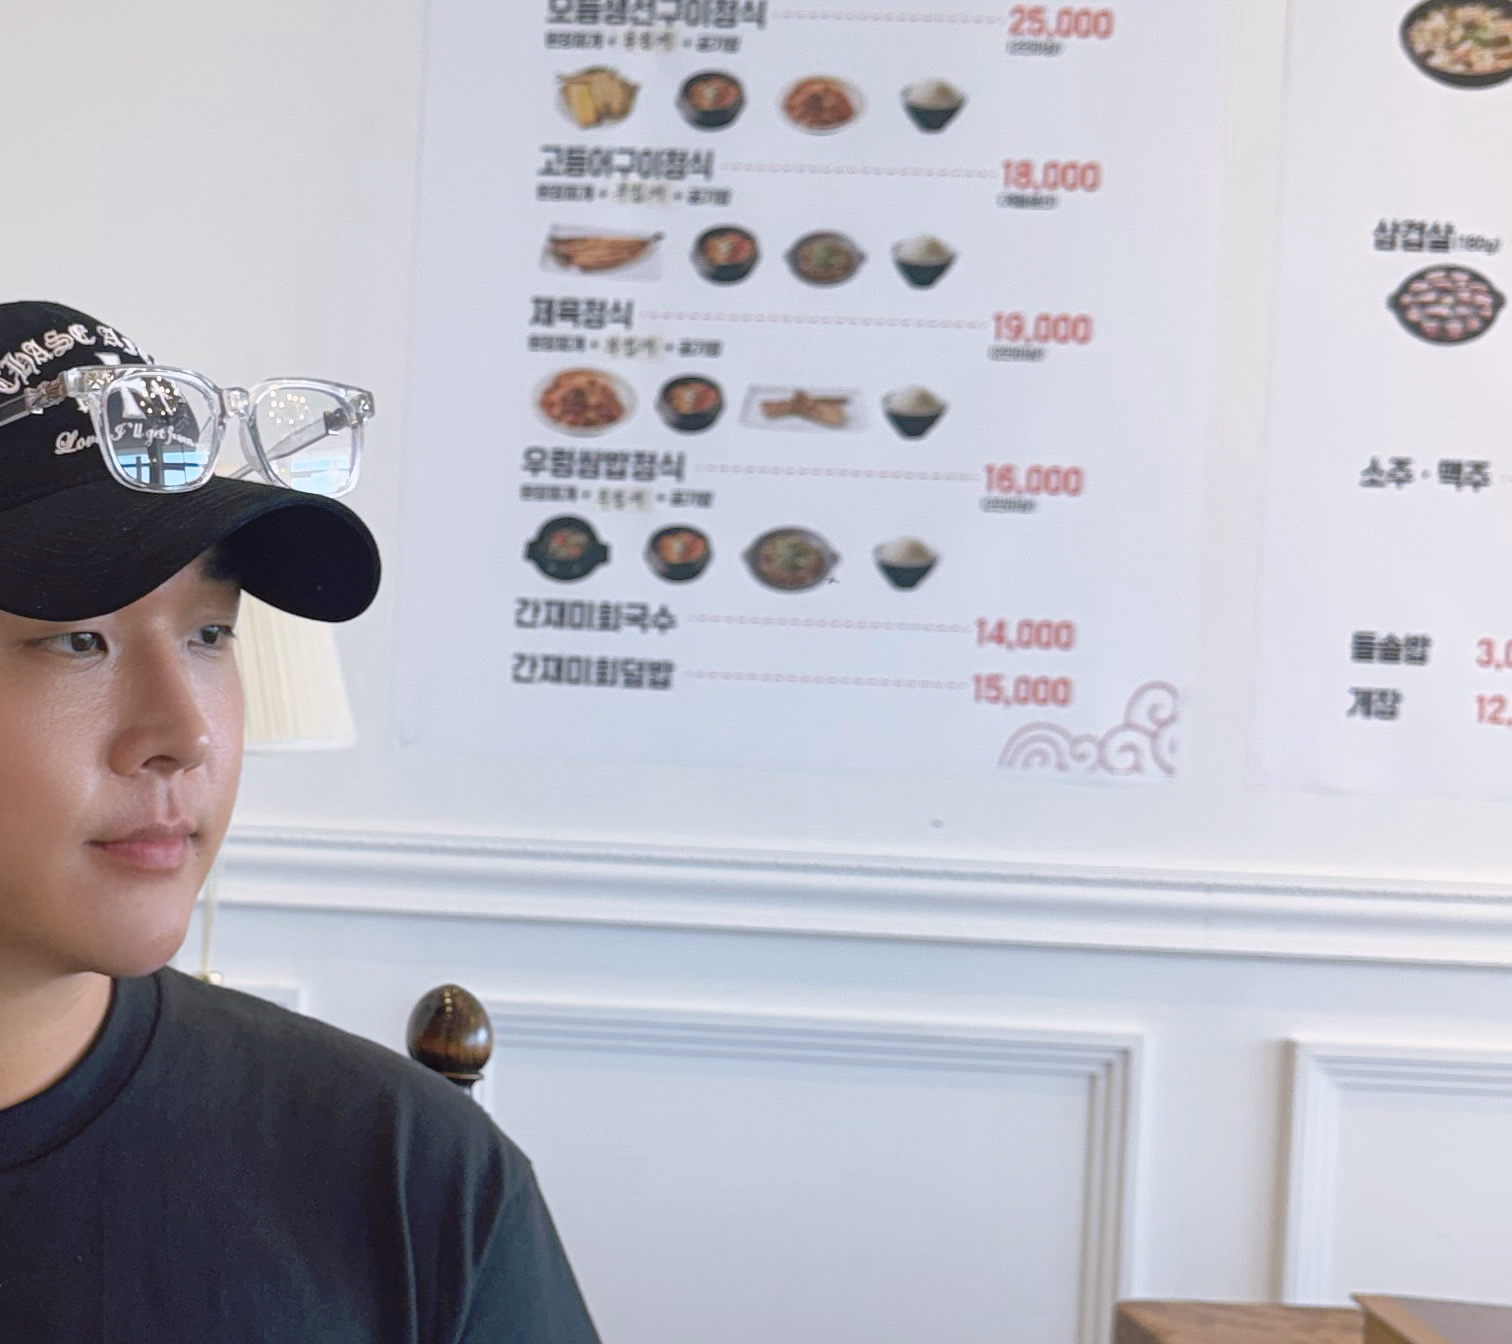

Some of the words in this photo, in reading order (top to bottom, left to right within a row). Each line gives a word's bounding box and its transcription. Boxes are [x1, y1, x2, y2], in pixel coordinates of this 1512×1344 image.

[1008, 5, 1115, 39] 25,000
[538, 145, 715, 181] 고등어구이정식
[1002, 160, 1102, 192] 18,000
[530, 297, 634, 330] 제육정식
[994, 313, 1093, 345] 19,000
[522, 447, 686, 483] 우렁쌈밥정식
[985, 464, 1084, 496] 16,000
[1359, 457, 1414, 489] 소주
[1437, 460, 1491, 492] 맥주
[514, 598, 677, 634] 간재미회국수
[975, 619, 1075, 651] 14,000
[511, 653, 675, 691] 간재미회덮밥
[972, 674, 1073, 708] 15,000
